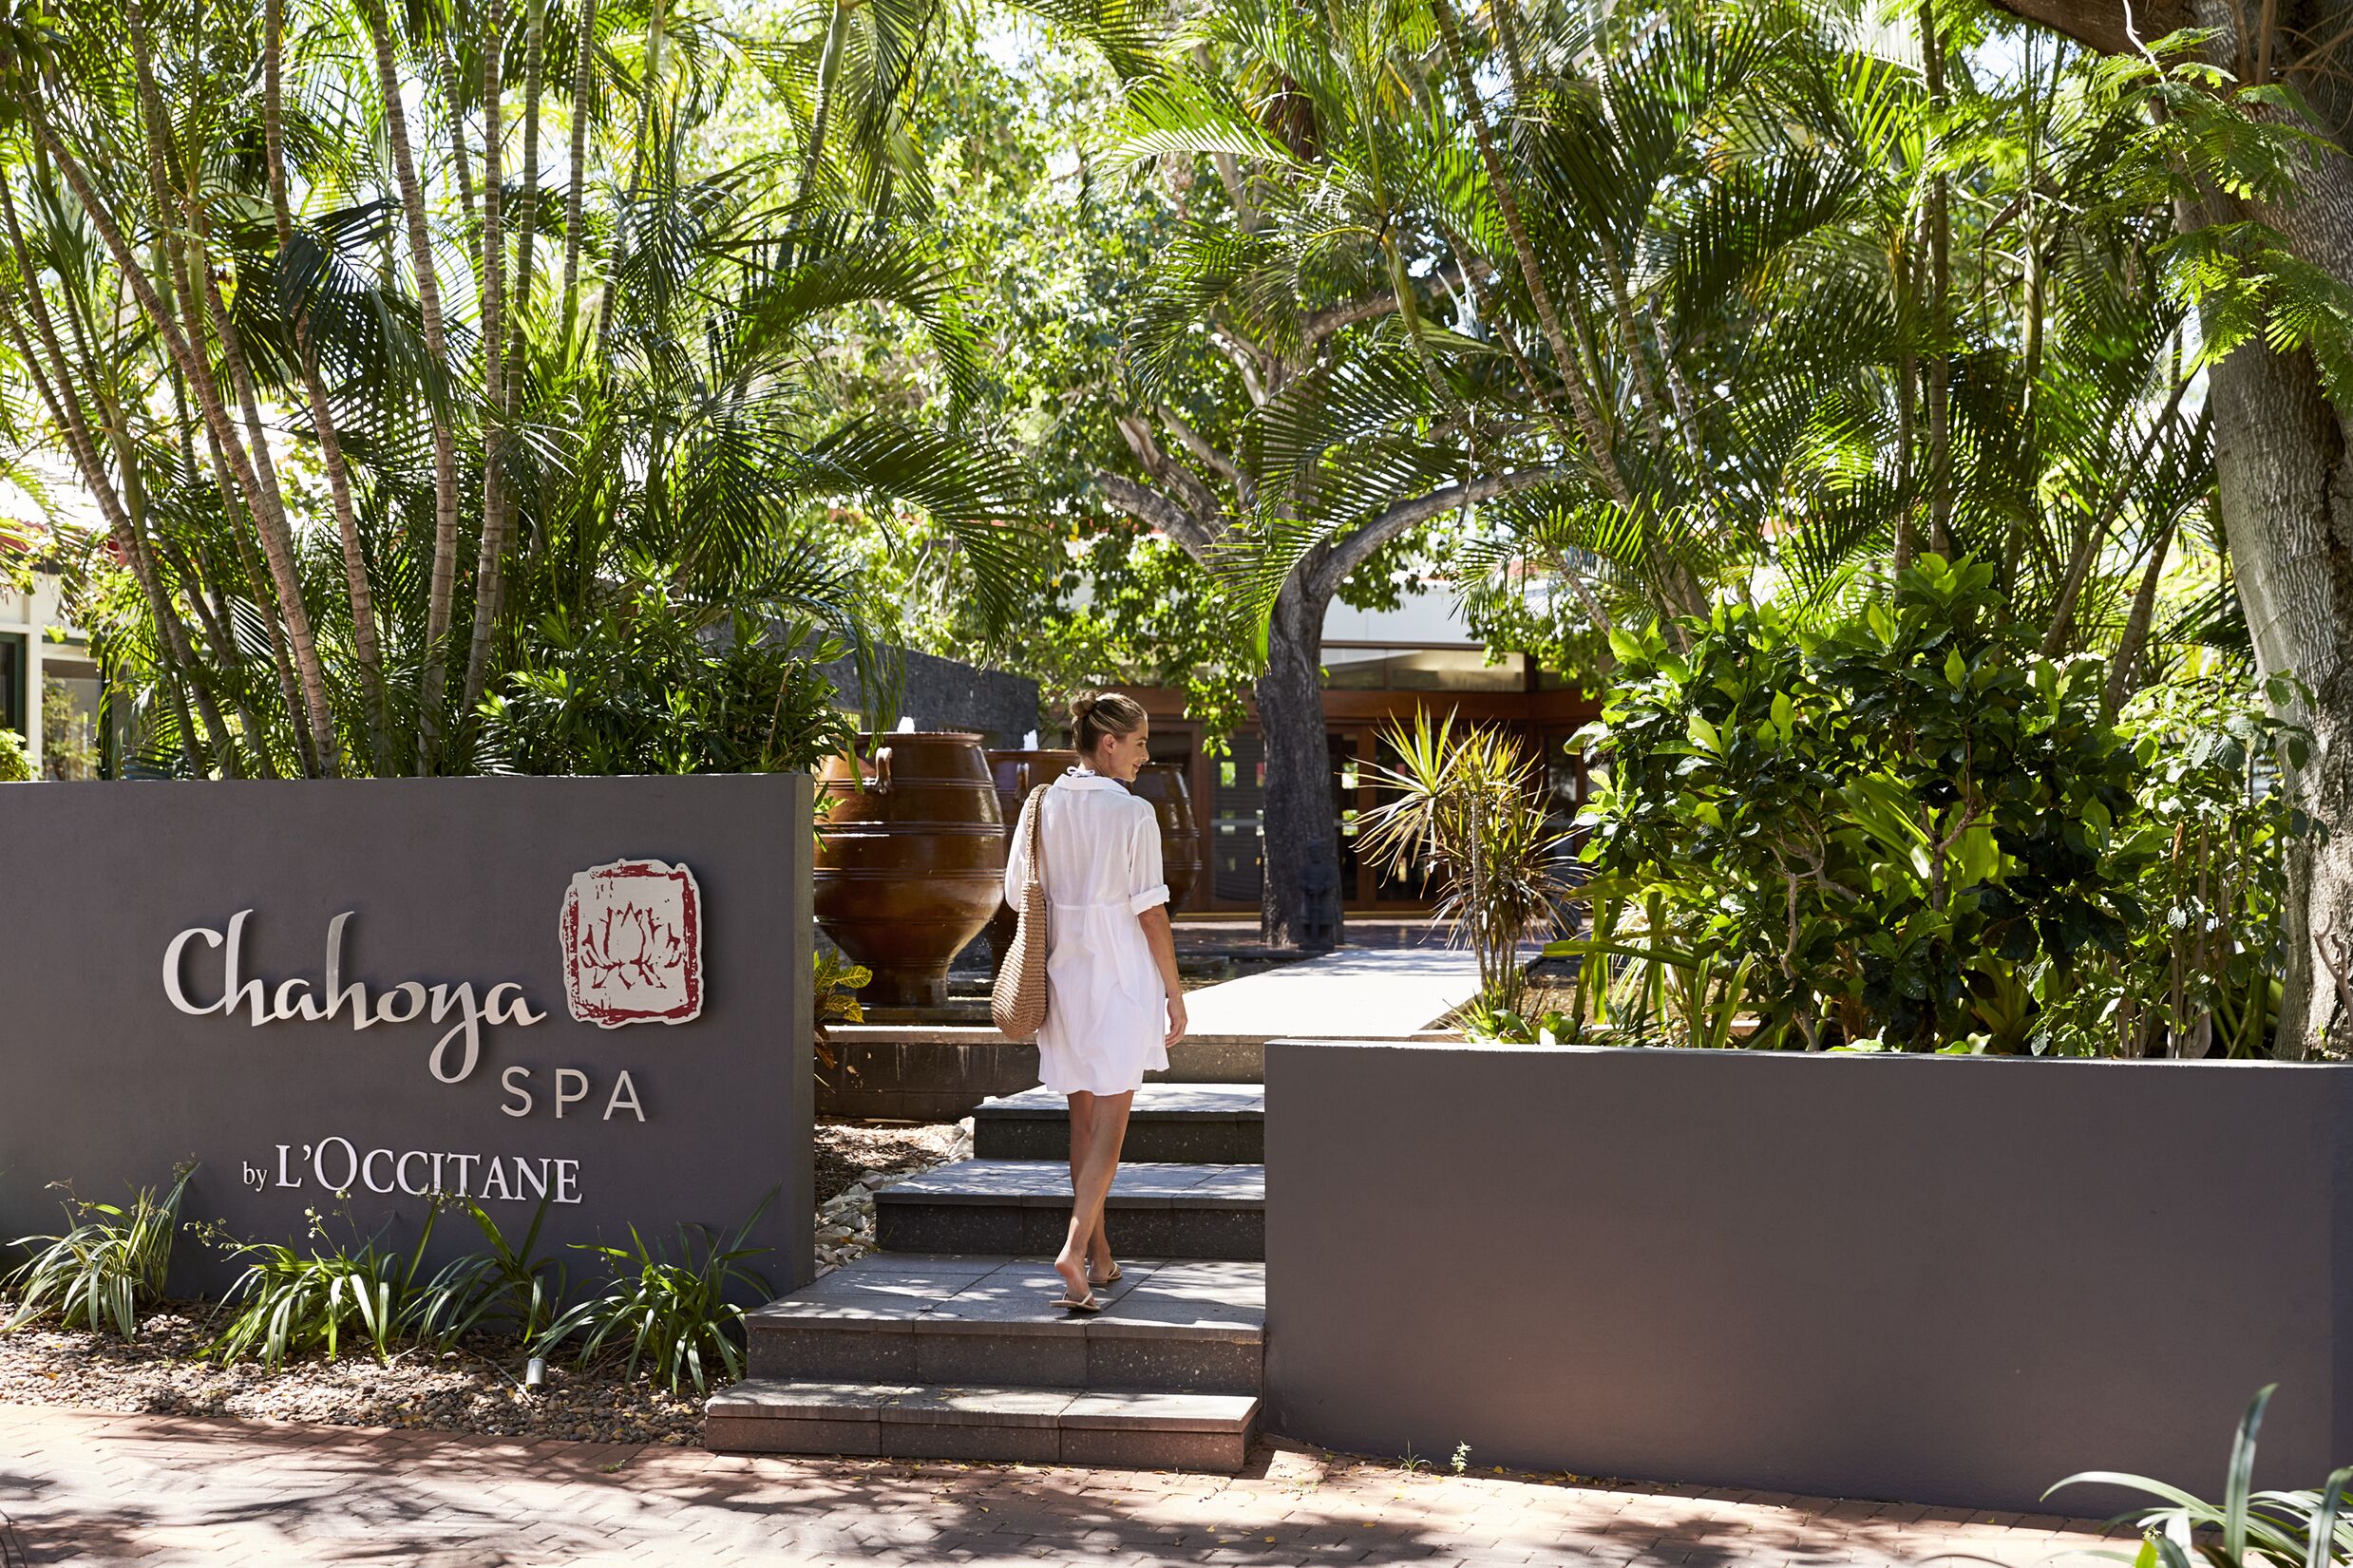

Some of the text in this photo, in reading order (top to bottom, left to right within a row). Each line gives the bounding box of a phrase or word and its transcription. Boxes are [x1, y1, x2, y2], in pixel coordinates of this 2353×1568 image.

[162, 909, 547, 1084] Chahoya
[501, 1066, 646, 1123] SPA
[242, 1136, 582, 1204] by L'OCCITANE
